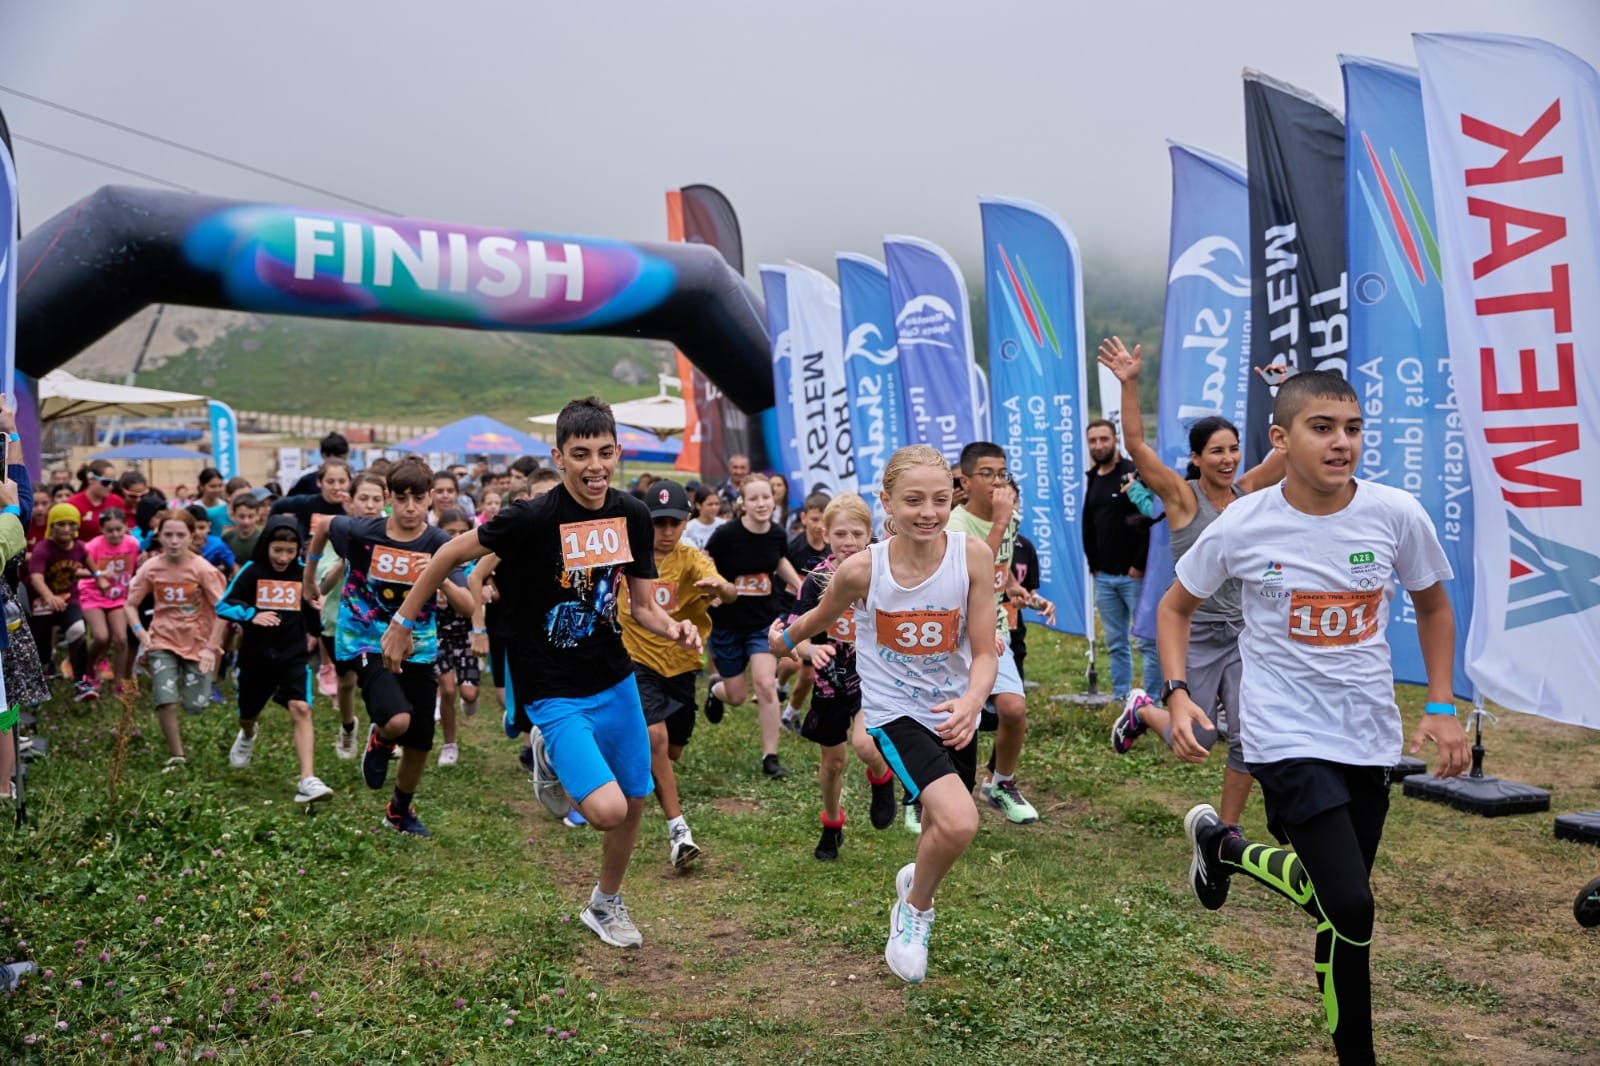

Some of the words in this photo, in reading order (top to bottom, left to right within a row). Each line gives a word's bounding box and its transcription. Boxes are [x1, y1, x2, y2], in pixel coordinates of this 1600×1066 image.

[294, 216, 584, 302] FINISH
[565, 528, 618, 559] 140
[376, 553, 410, 576] 85
[164, 587, 187, 601] 31
[257, 586, 296, 603] 123
[836, 618, 856, 635] 3
[1291, 604, 1367, 637] 101
[895, 621, 944, 648] 38
